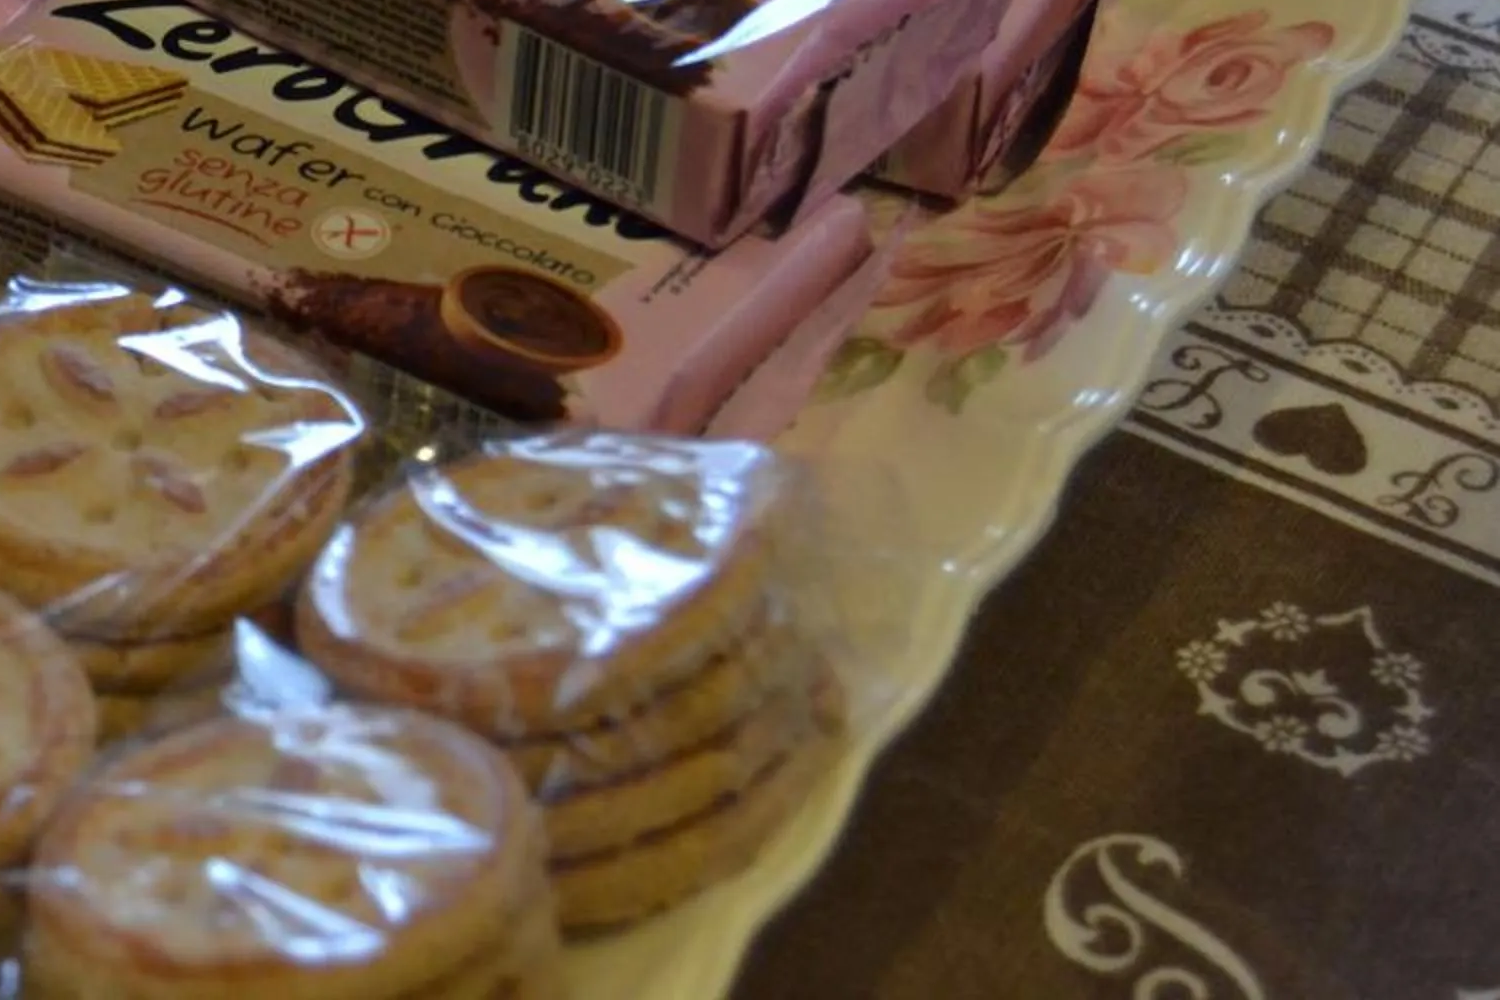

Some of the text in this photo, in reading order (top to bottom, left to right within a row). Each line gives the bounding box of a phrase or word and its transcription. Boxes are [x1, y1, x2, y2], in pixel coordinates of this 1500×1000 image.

[174, 148, 310, 208] senza
[180, 107, 366, 188] wafer
[362, 186, 422, 218] con
[137, 168, 303, 236] glutine
